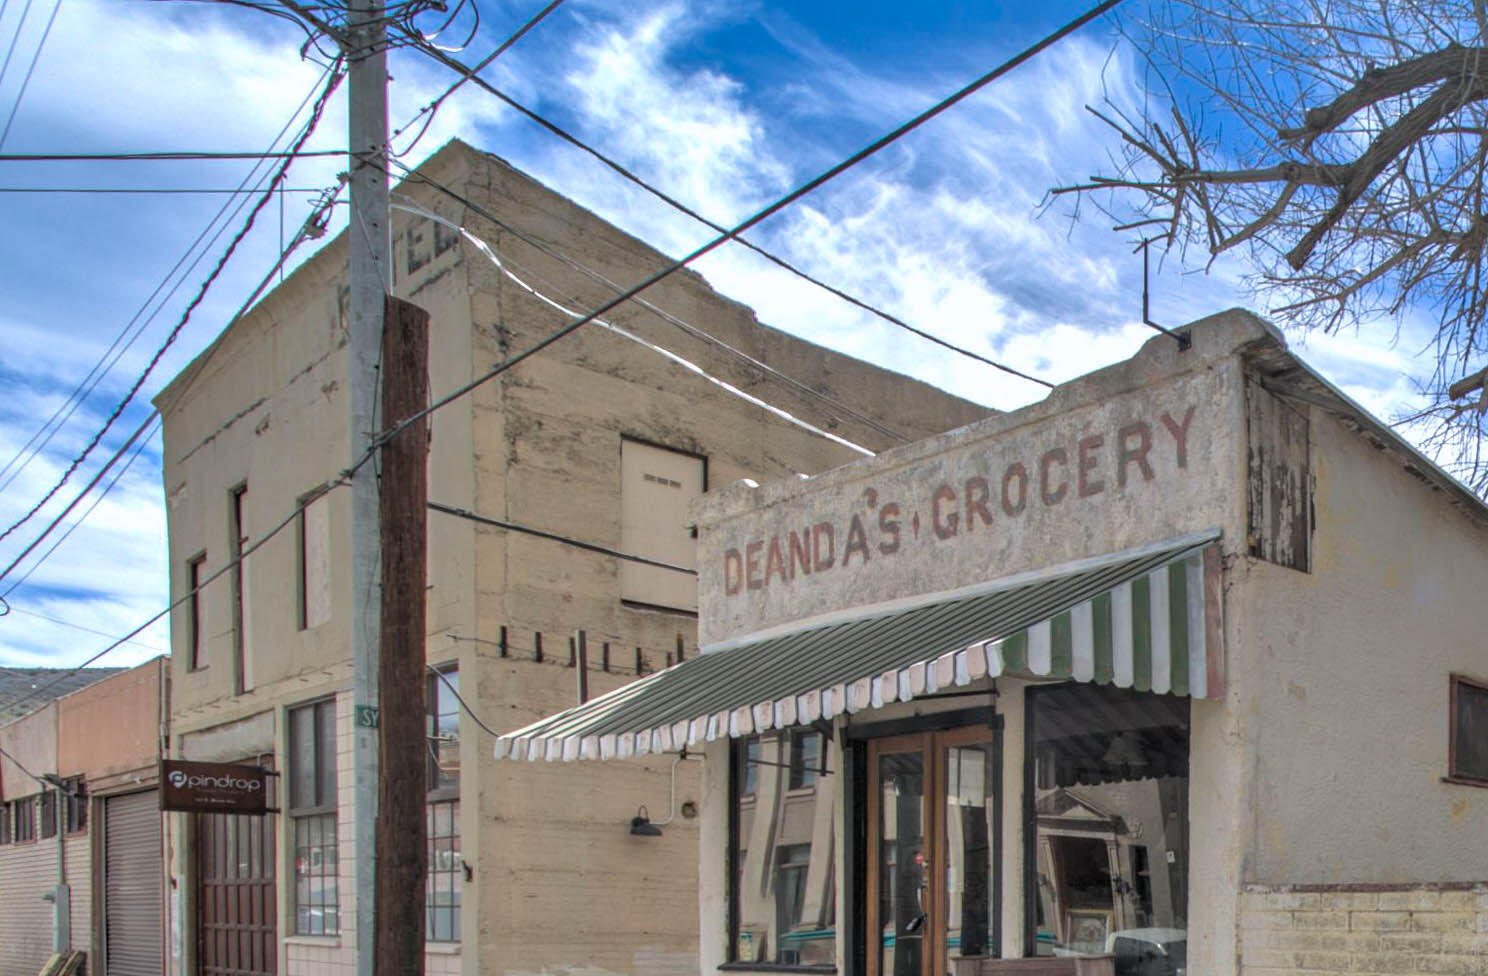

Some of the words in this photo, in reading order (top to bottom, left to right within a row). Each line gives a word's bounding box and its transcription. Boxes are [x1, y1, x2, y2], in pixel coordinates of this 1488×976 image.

[723, 486, 902, 597] DEANDA'S
[932, 404, 1197, 541] GROCERY
[187, 774, 261, 793] pindrop
